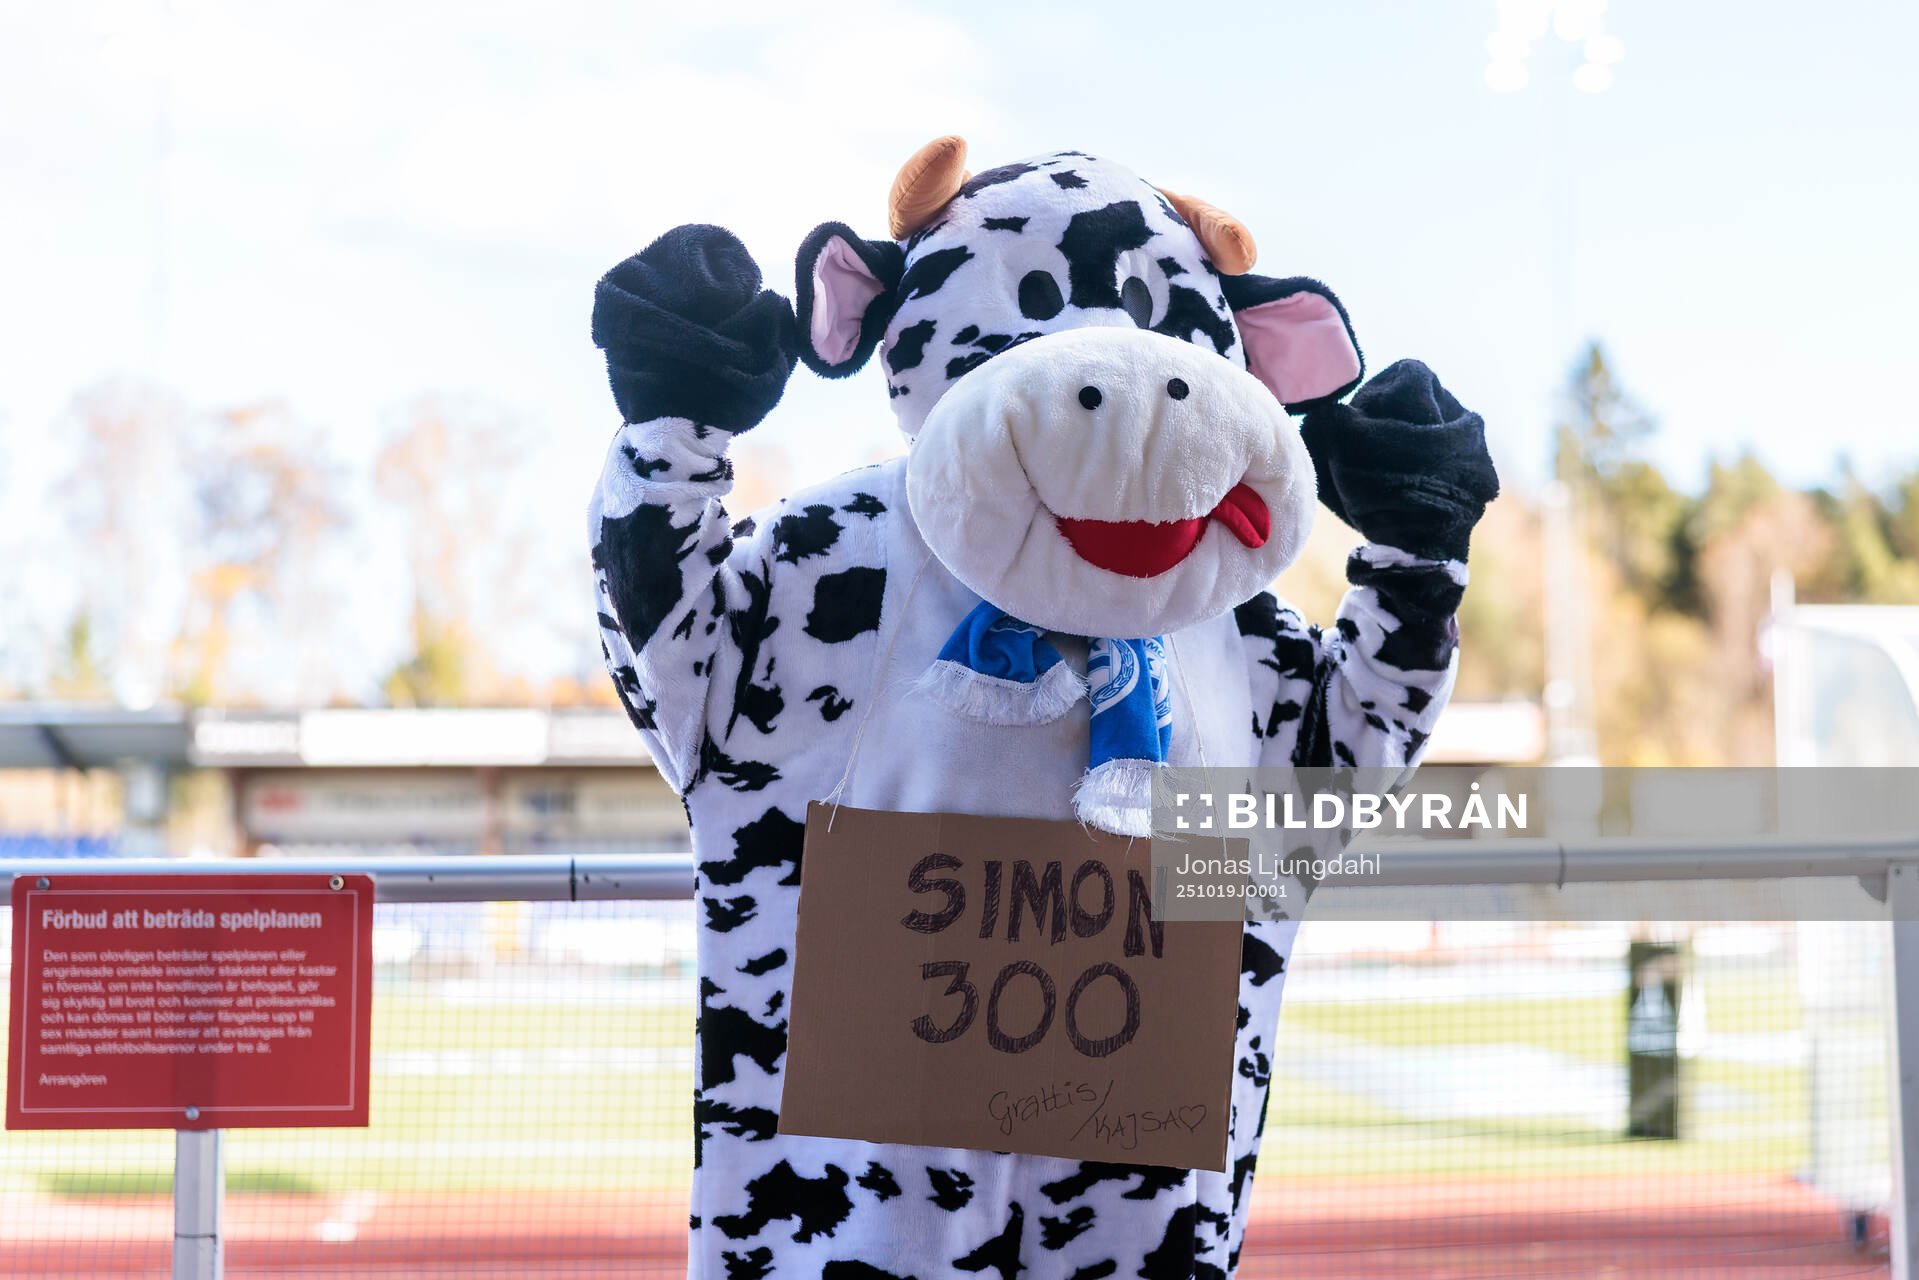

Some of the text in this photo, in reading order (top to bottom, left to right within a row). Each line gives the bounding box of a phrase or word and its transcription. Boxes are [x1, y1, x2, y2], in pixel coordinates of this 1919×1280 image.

[900, 853, 1168, 958] SIMON
[43, 909, 321, 932] Förbud att beträda spelplanen
[44, 950, 67, 962] Den
[71, 952, 97, 961] som
[157, 950, 208, 961] beträder
[212, 950, 277, 962] spelplanen
[280, 950, 306, 961] eller
[117, 966, 163, 977] område
[270, 965, 297, 976] eller
[299, 966, 336, 976] kastar
[108, 983, 128, 992] om
[156, 981, 223, 994] handlingen
[226, 981, 239, 991] är
[298, 981, 319, 994] gör
[42, 998, 60, 1010] sig
[63, 997, 105, 1010] skyldig
[109, 996, 123, 1007] till
[126, 997, 155, 1007] brott
[158, 997, 181, 1007] och
[184, 997, 233, 1007] kommer
[236, 996, 252, 1007] att
[910, 960, 1140, 1058] 300
[41, 1012, 64, 1023] och
[67, 1013, 89, 1023] kan
[92, 1012, 133, 1023] dömas
[137, 1011, 151, 1022] till
[154, 1012, 185, 1023] böter
[189, 1012, 215, 1022] eller
[272, 1012, 297, 1025] upp
[299, 1010, 314, 1022] till
[41, 1030, 61, 1039] sex
[65, 1028, 119, 1038] månader
[122, 1028, 151, 1038] samt
[203, 1027, 219, 1037] att
[288, 1026, 312, 1037] från
[40, 1043, 91, 1056] samtliga
[199, 1043, 234, 1053] under
[237, 1043, 254, 1053] tre
[39, 1074, 107, 1087] Arrangören
